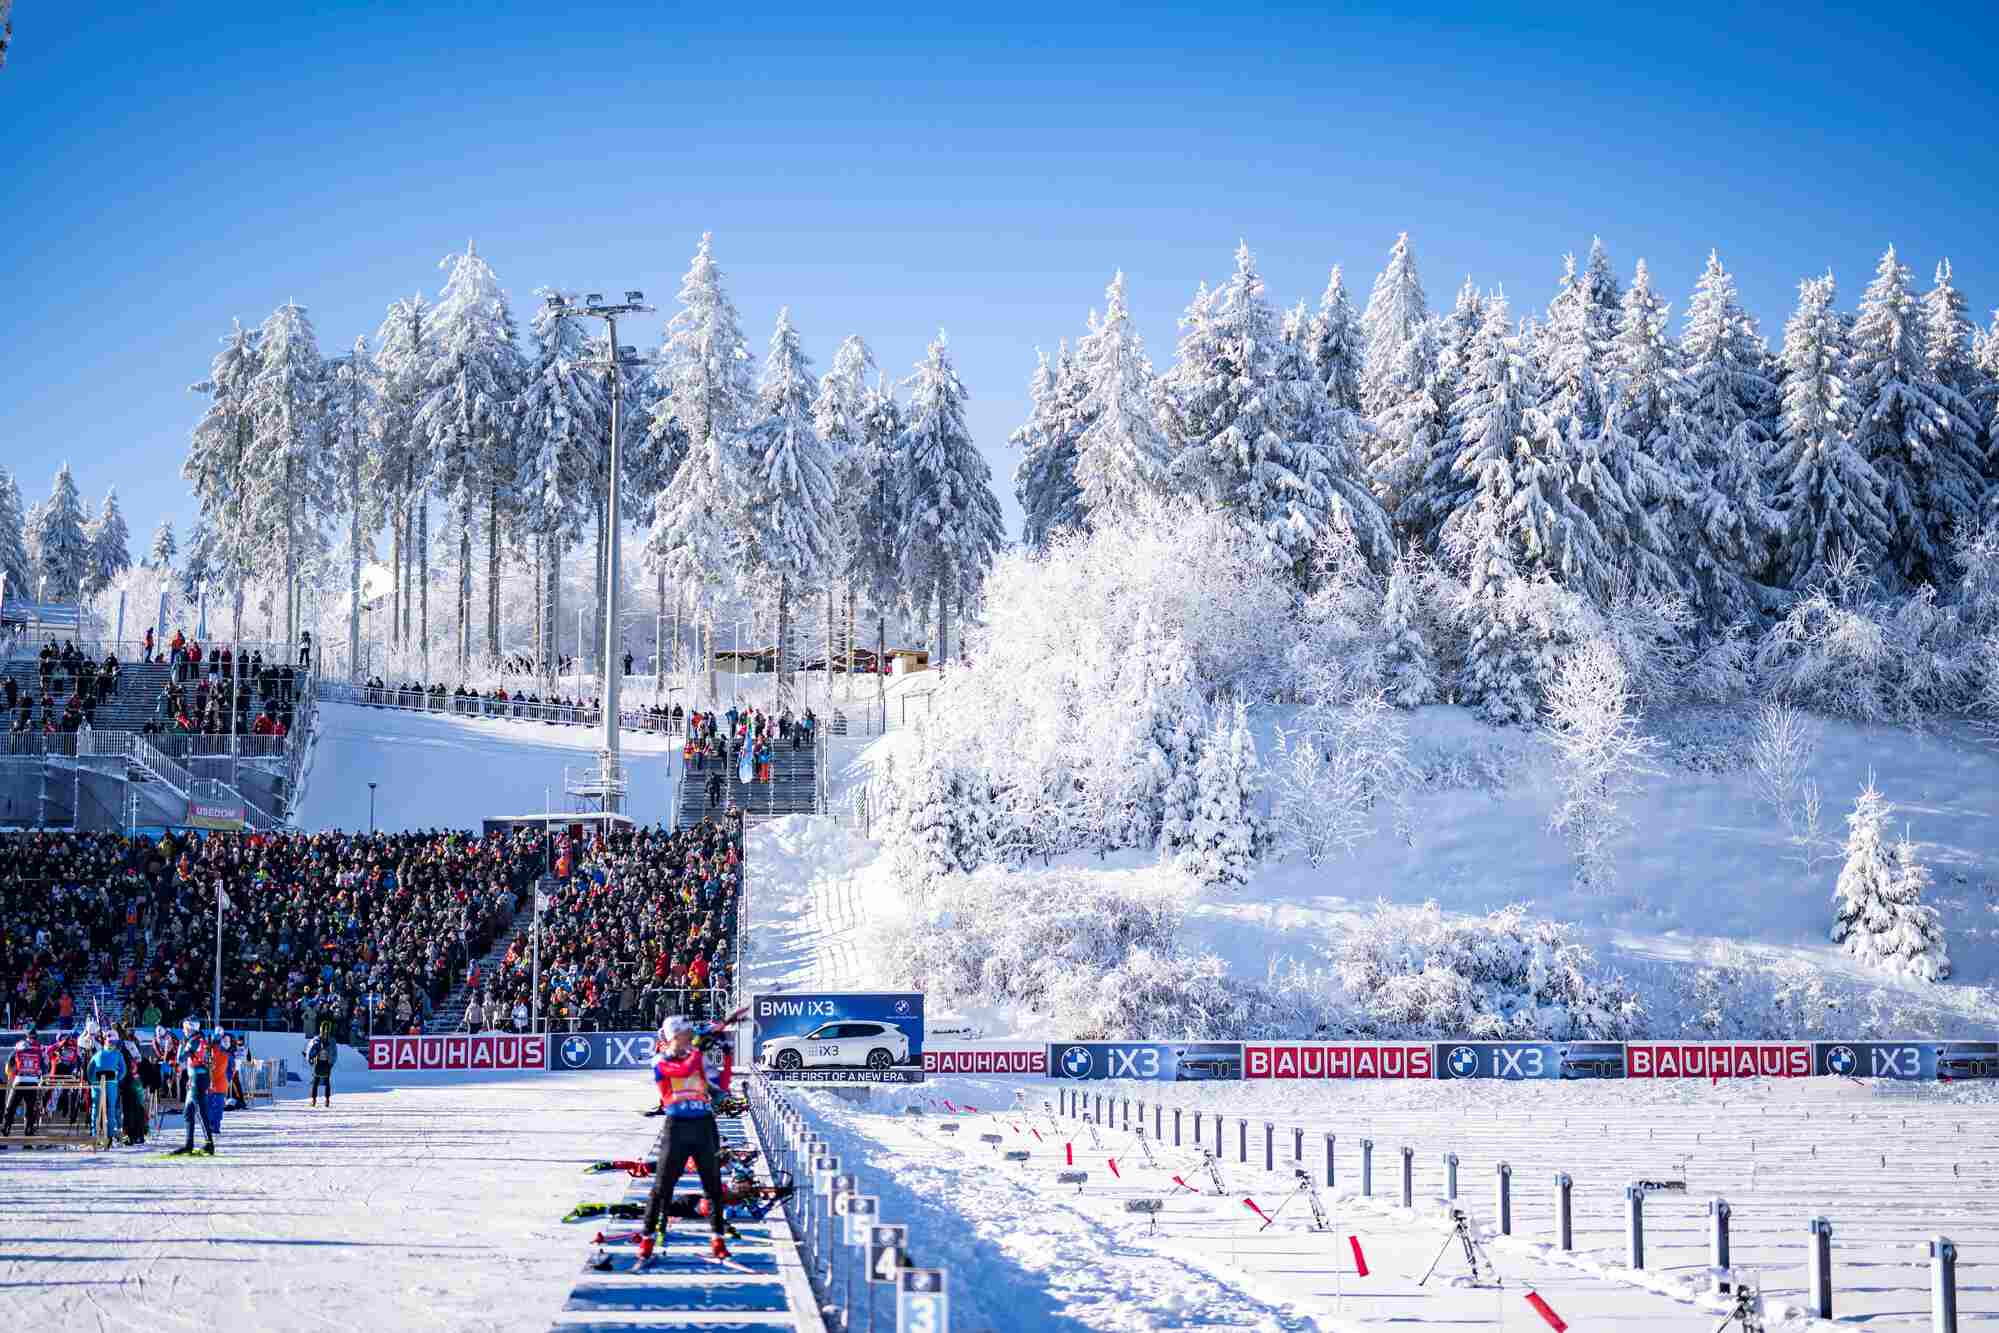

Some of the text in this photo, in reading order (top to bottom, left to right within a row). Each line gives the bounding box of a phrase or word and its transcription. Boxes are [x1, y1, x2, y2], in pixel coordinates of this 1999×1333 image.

[760, 1001, 835, 1017] BMW iX3
[373, 1042, 542, 1065] BAUHAUS
[605, 1037, 656, 1065] iX3
[819, 1045, 839, 1057] iX3
[923, 1053, 1045, 1071] BAUHAUS
[1107, 1048, 1160, 1077] iX3
[1250, 1051, 1429, 1074] BAUHAUS
[1493, 1048, 1544, 1077] iX3
[1633, 1051, 1809, 1074] BAUHAUS
[1871, 1048, 1921, 1076] iX3
[801, 1072, 829, 1081] FIRST
[832, 1072, 846, 1081] OF
[847, 1072, 856, 1081] A
[858, 1072, 881, 1081] NEW
[875, 1246, 898, 1281] 4
